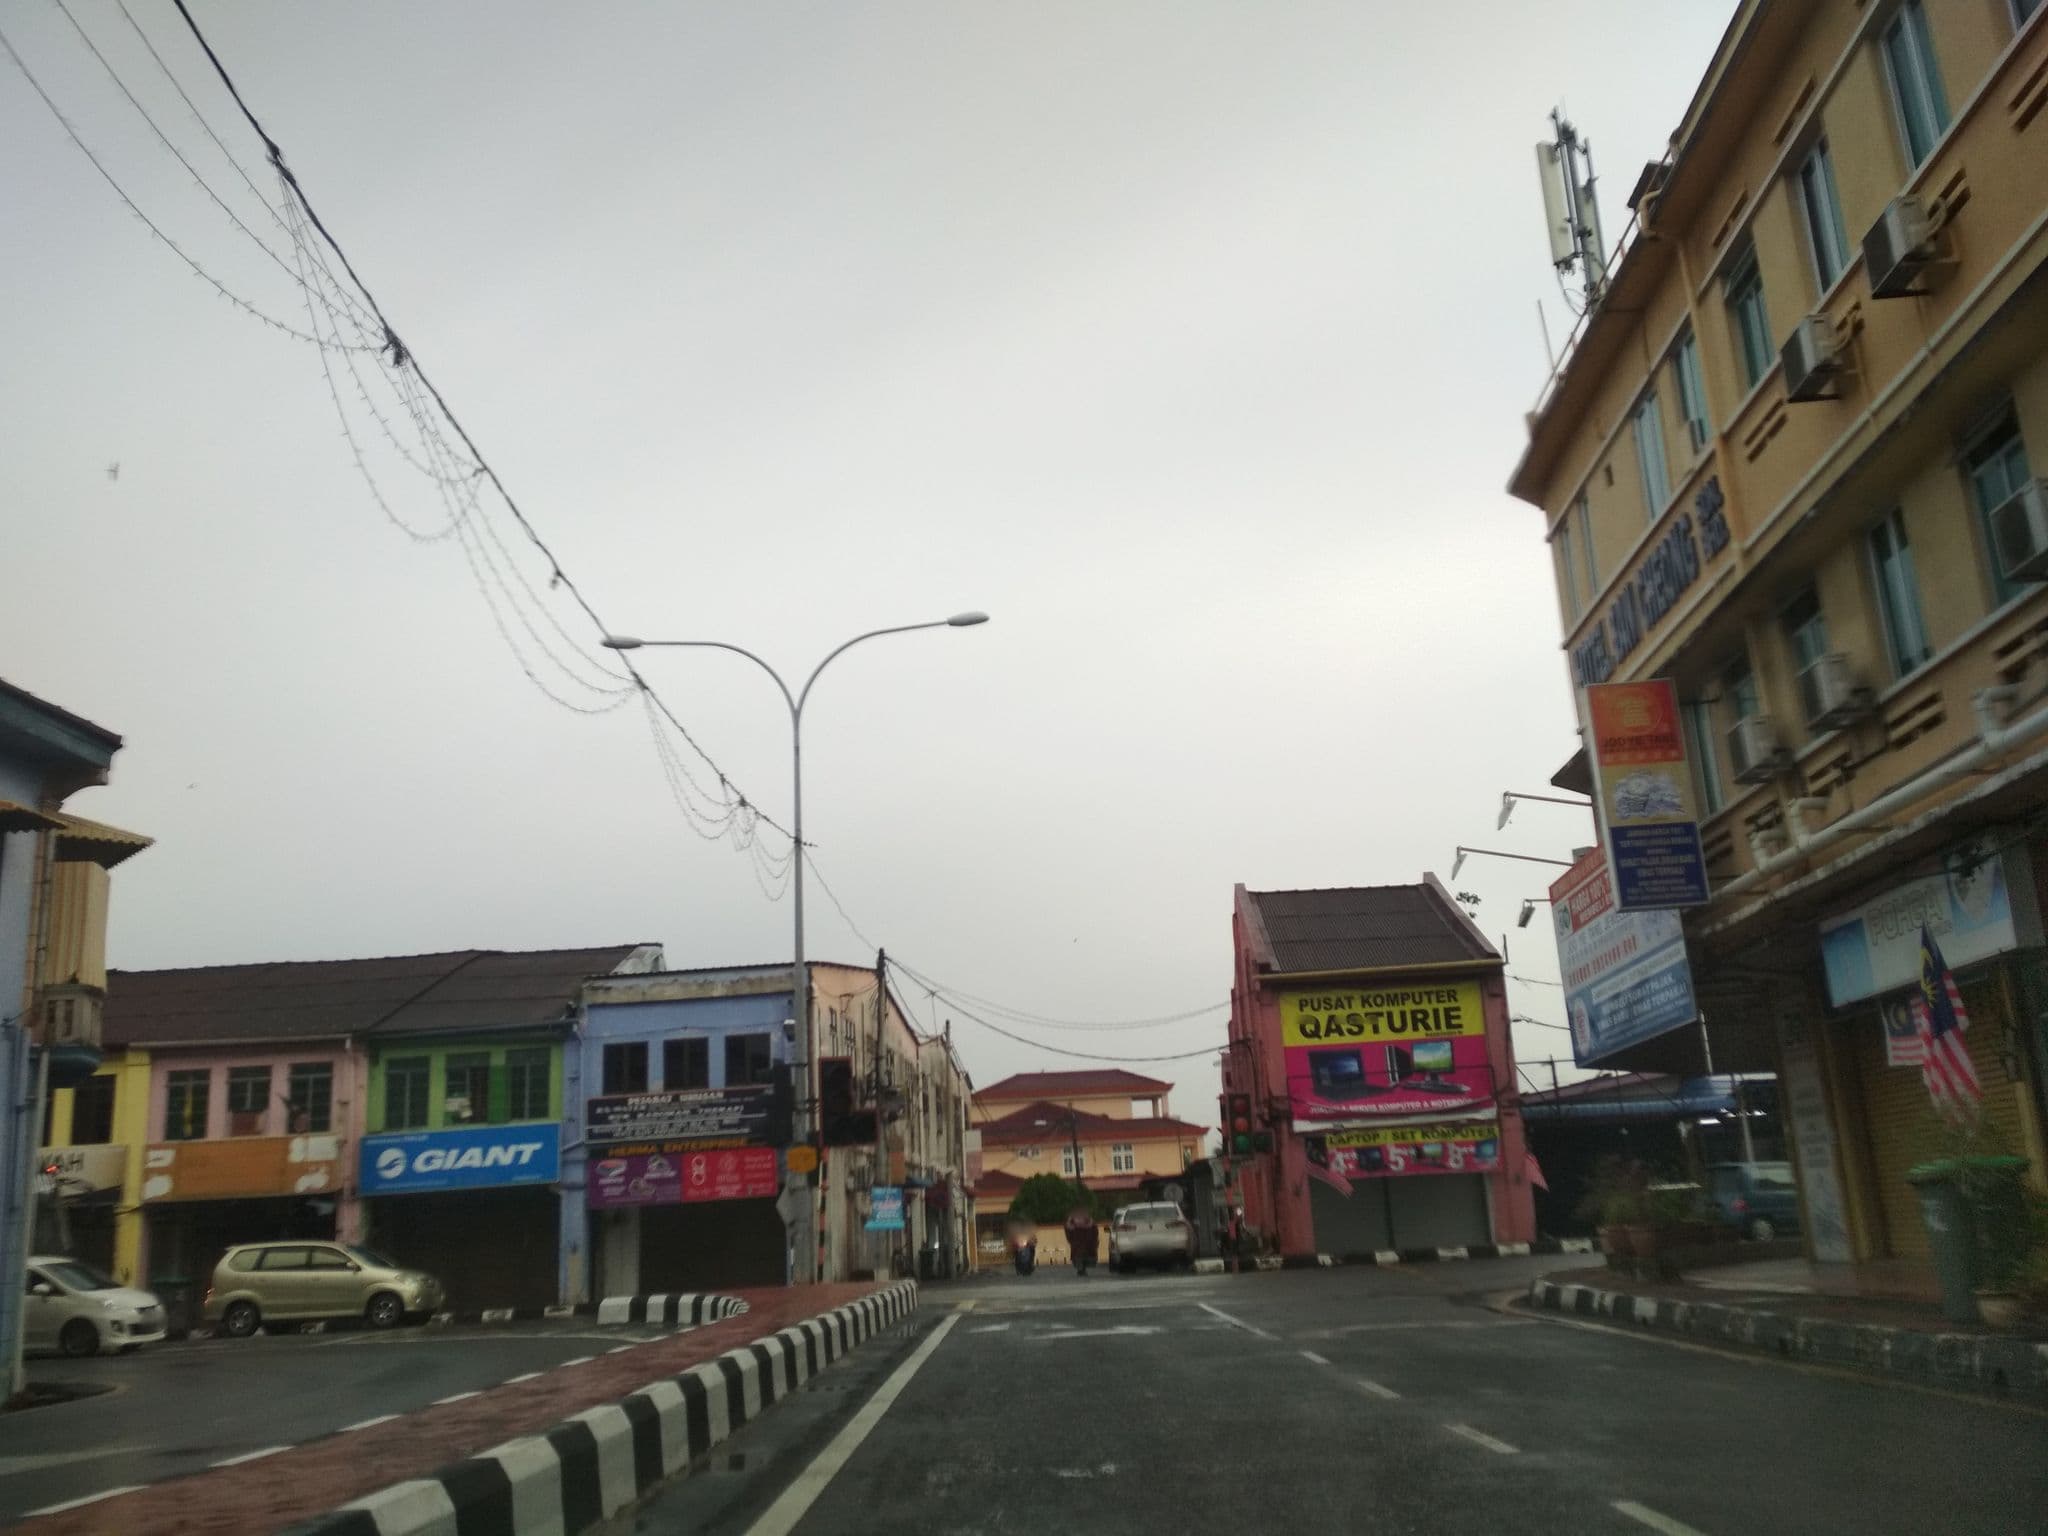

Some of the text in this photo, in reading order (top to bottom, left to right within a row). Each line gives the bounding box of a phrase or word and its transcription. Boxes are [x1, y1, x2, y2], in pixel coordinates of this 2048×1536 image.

[1299, 989, 1458, 1012] PUSAT KOMPUTER
[1300, 1007, 1463, 1039] QASTURIE
[1328, 1133, 1380, 1145] LAPTOP
[1393, 1130, 1415, 1141] SET
[1421, 1125, 1497, 1140] KOMPUTER
[412, 1142, 543, 1173] GIANT
